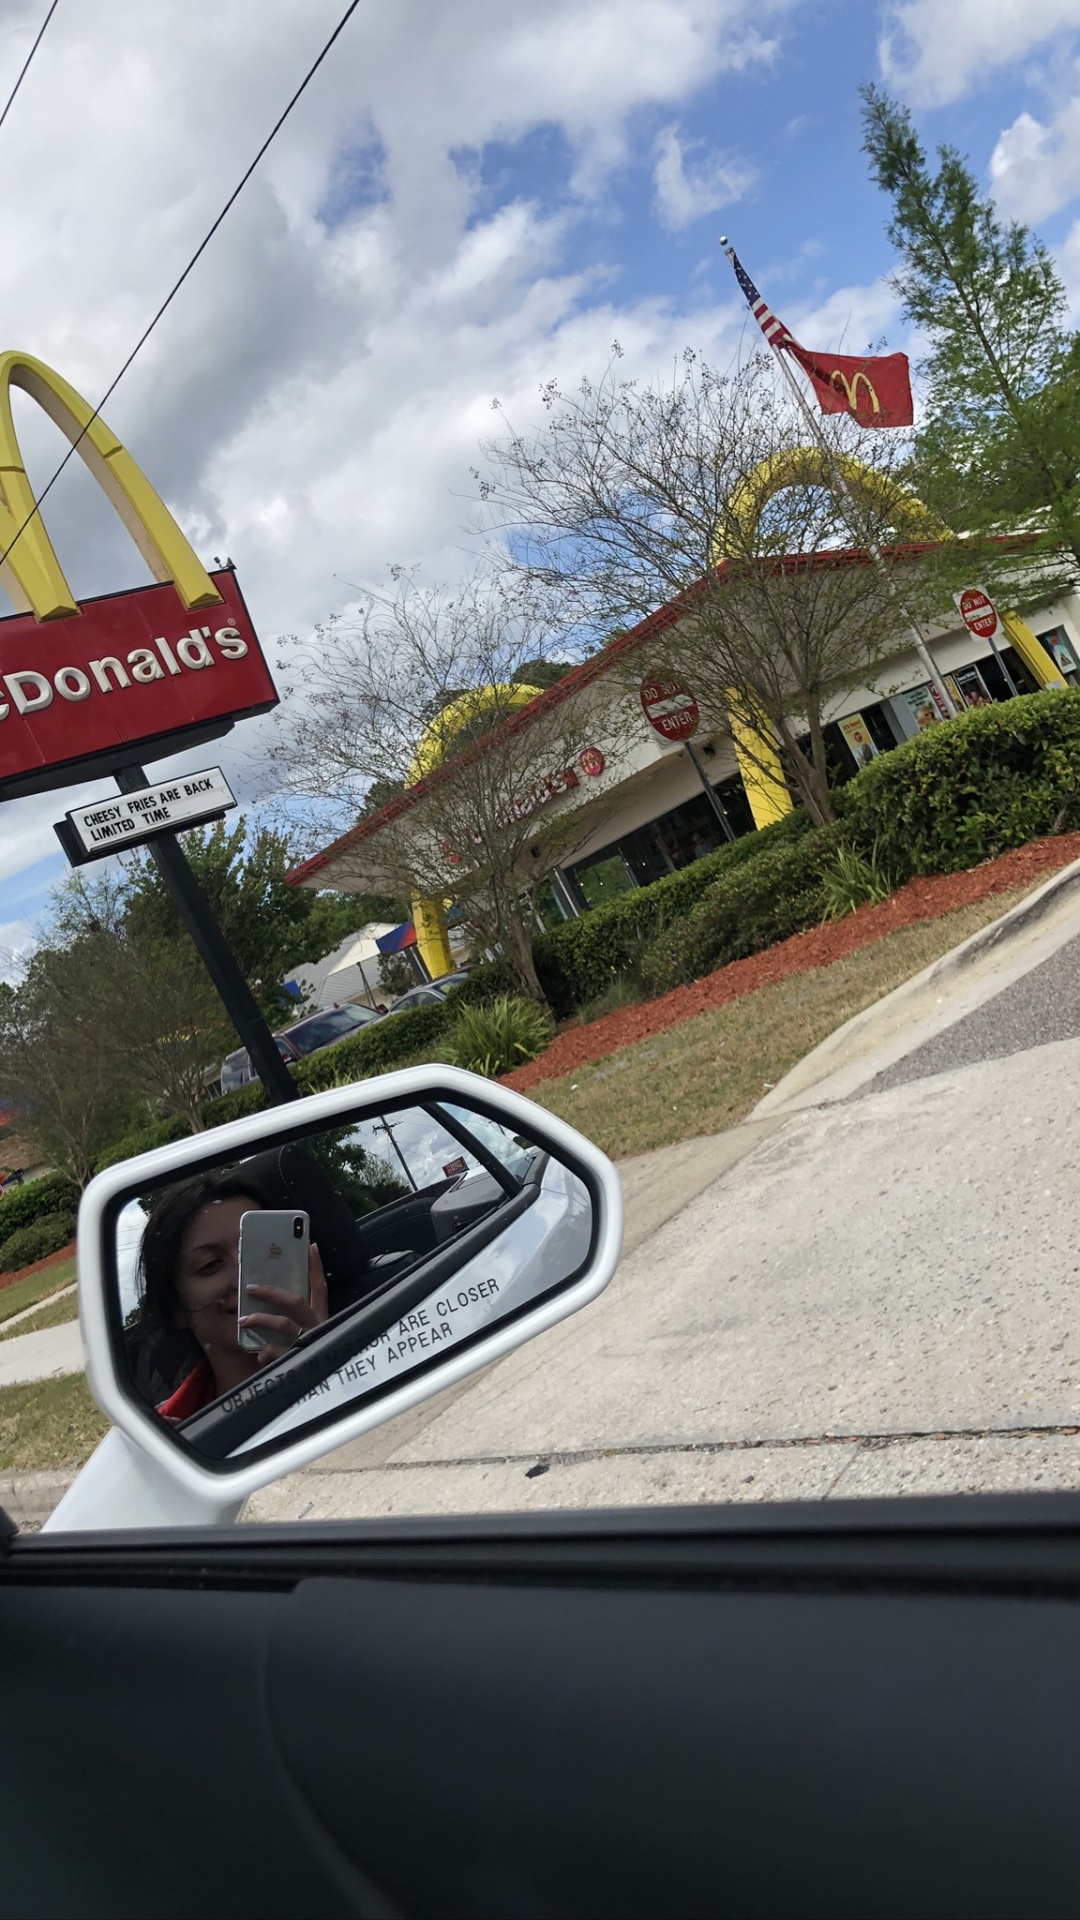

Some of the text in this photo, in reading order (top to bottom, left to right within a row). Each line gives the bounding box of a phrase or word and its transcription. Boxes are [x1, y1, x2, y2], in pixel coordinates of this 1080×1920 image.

[973, 595, 986, 609] NOT
[973, 615, 994, 631] ENTER
[0, 626, 249, 720] Donald's
[643, 687, 659, 702] DO
[661, 711, 693, 731] ENTER
[84, 778, 213, 828] CHEESY FRIES ARE BACK
[90, 807, 171, 841] LIMITED TIME
[220, 1369, 296, 1413] OBJECTS
[398, 1310, 430, 1337] ARE
[436, 1278, 500, 1316] CLOSER
[281, 1322, 453, 1408] HAN THEY APPEAR
